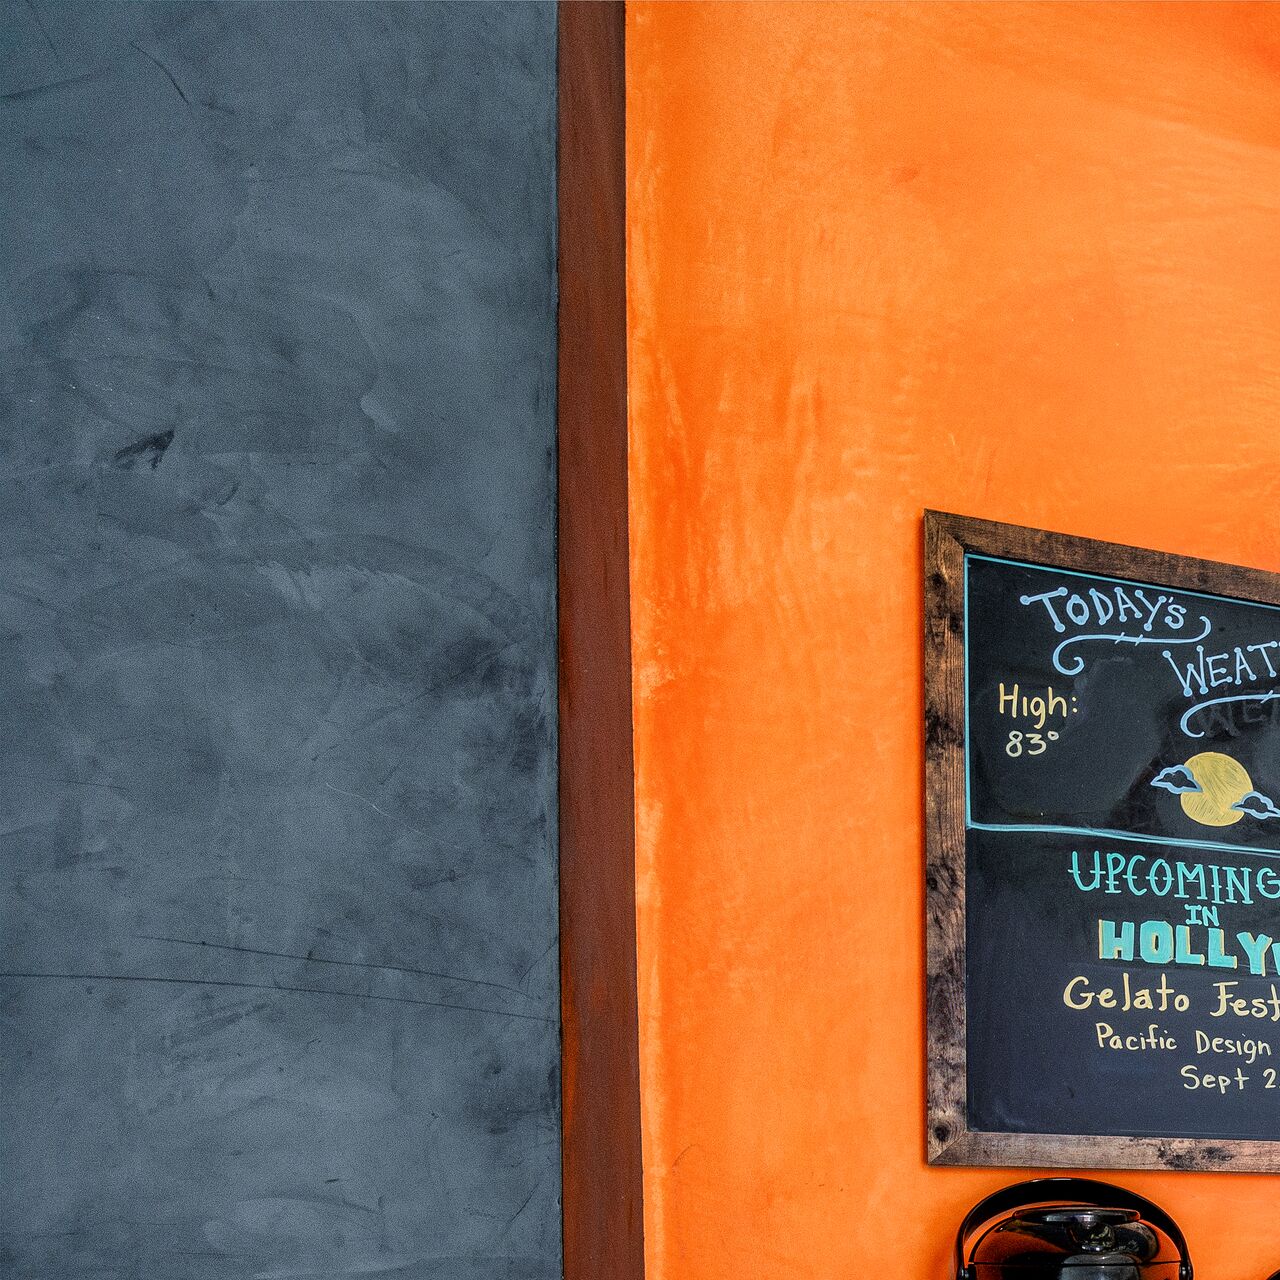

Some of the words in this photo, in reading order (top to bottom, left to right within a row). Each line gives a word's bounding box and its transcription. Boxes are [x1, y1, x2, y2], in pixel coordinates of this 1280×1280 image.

[998, 682, 1079, 729] High:
[1184, 903, 1220, 927] IN
[1062, 972, 1190, 1012] Gelato
[1095, 1022, 1178, 1051] Pacific
[1195, 1029, 1272, 1065] Design
[1180, 1061, 1251, 1095] Sept
